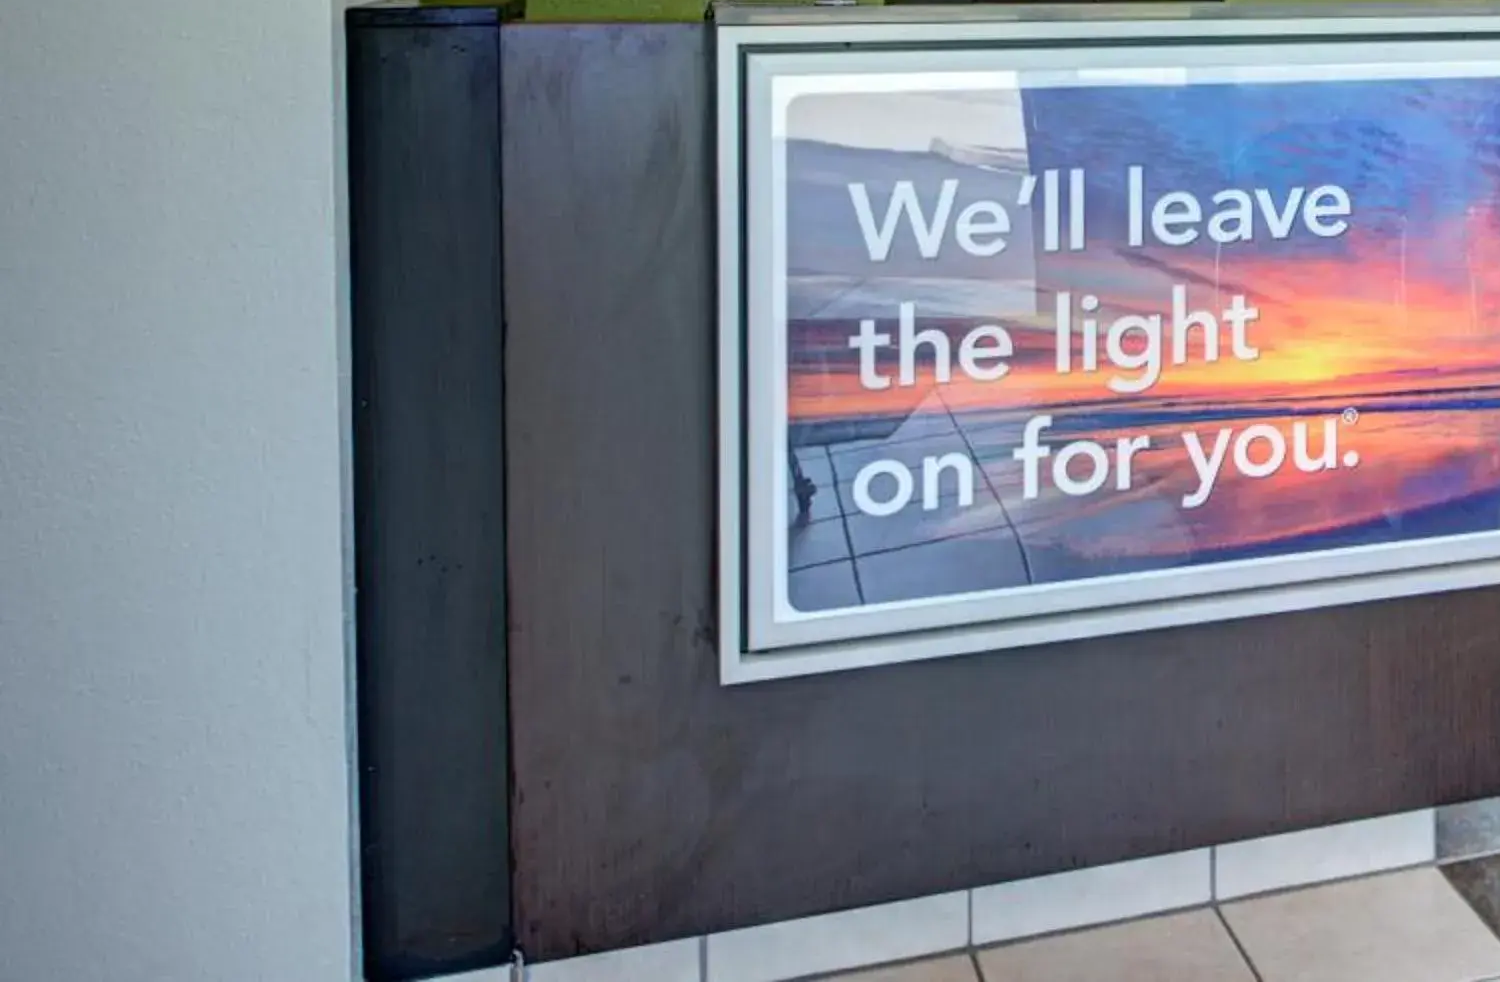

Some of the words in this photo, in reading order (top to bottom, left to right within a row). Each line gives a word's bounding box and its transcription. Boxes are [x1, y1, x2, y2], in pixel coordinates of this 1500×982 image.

[847, 168, 1086, 263] We'll
[1127, 165, 1351, 248] leave
[851, 303, 1013, 390] the
[1055, 284, 1260, 393] light
[851, 449, 974, 518] on
[1013, 416, 1151, 501] for
